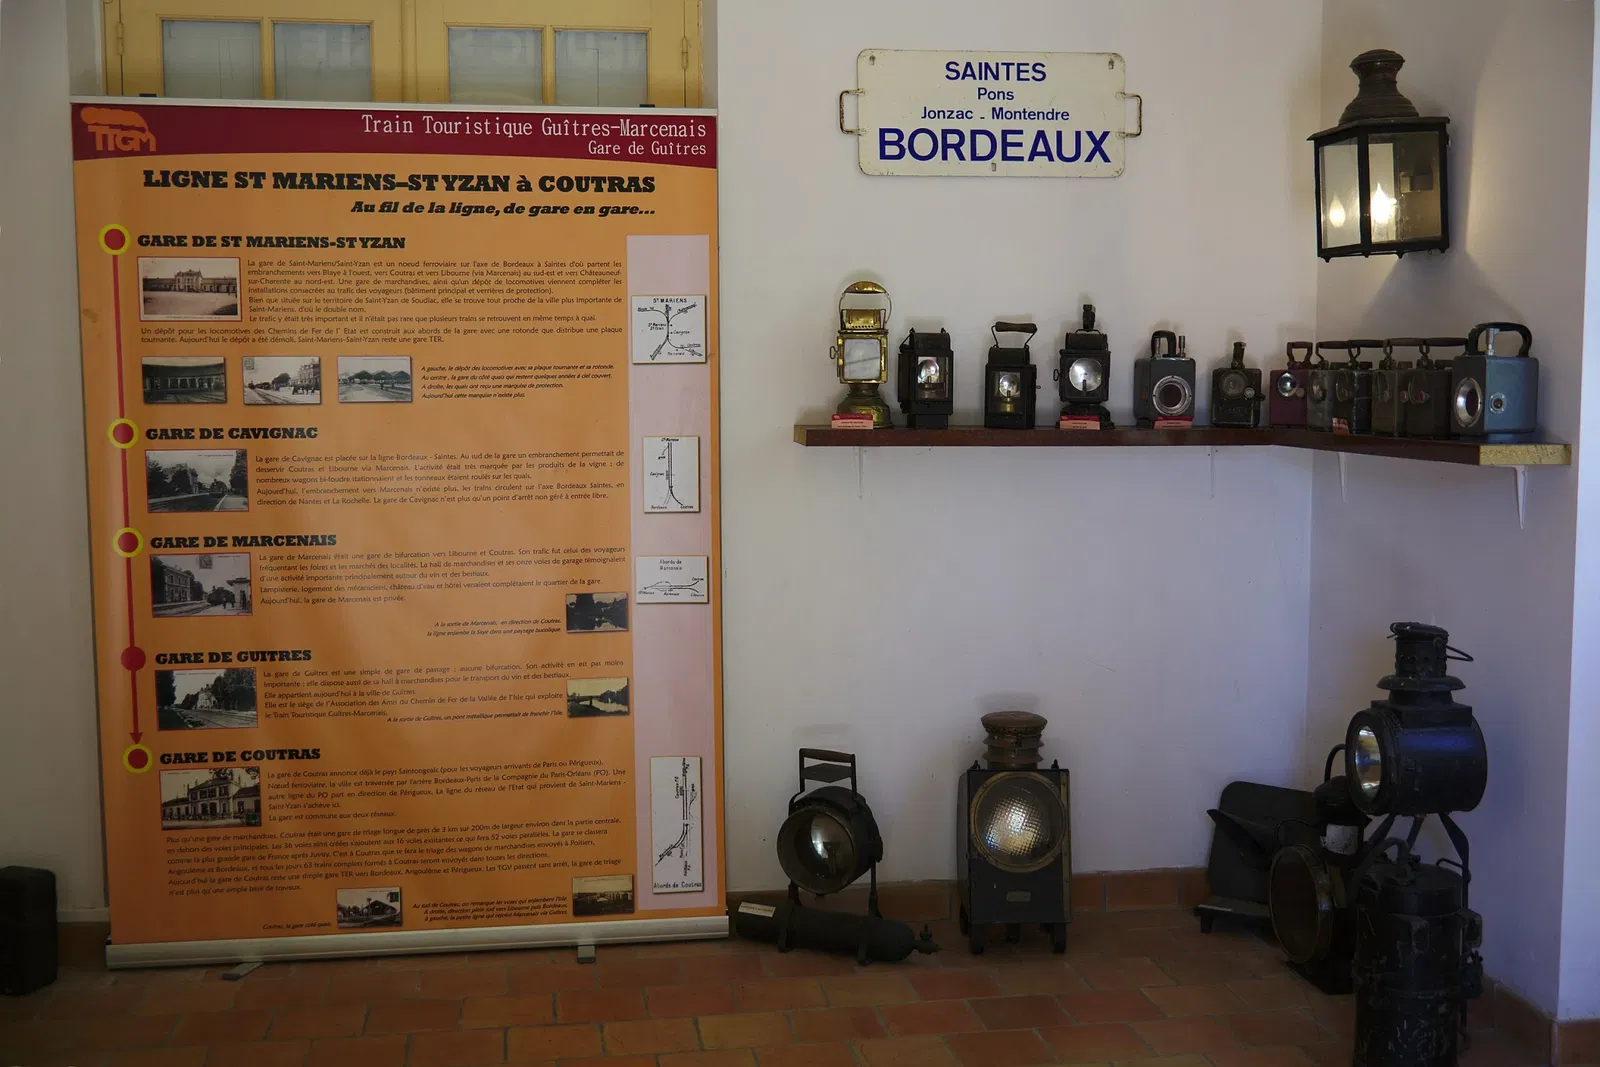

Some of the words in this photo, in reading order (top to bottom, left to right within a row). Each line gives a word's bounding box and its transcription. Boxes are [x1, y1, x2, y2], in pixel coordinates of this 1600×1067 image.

[945, 62, 1047, 82] SAINTES
[978, 87, 1015, 101] Pons
[921, 106, 974, 120] Jonzac
[992, 107, 1070, 121] Montendre
[362, 114, 413, 134] Train
[422, 116, 532, 138] Touristique
[542, 118, 706, 137] Guîtres-Marcenais
[588, 140, 620, 155] Gare
[628, 140, 644, 155] de
[651, 141, 706, 156] Guîtres
[878, 128, 1111, 163] BORDEAUX
[143, 170, 228, 188] LIGNE
[516, 175, 533, 192] à
[538, 175, 656, 194] COUTRAS
[350, 201, 376, 213] Au
[378, 201, 400, 213] fil
[402, 202, 425, 213] de
[427, 202, 446, 214] la
[448, 202, 501, 217] ligne,
[503, 203, 526, 214] de
[528, 206, 570, 217] gare
[573, 206, 596, 214] en
[137, 235, 188, 247] GARE
[192, 236, 218, 247] DE
[145, 428, 196, 440] GARE
[199, 428, 224, 440] DE
[228, 428, 318, 439] CAVIGNAC
[409, 496, 439, 504] Cavignac
[150, 537, 200, 549] GARE
[203, 536, 228, 548] DE
[232, 535, 337, 547] MARCENAIS
[155, 652, 204, 664] GARE
[208, 652, 232, 663] DE
[236, 650, 312, 662] GUITRES
[160, 752, 209, 765] GARE
[212, 751, 237, 763] DE
[240, 748, 321, 762] COUTRAS
